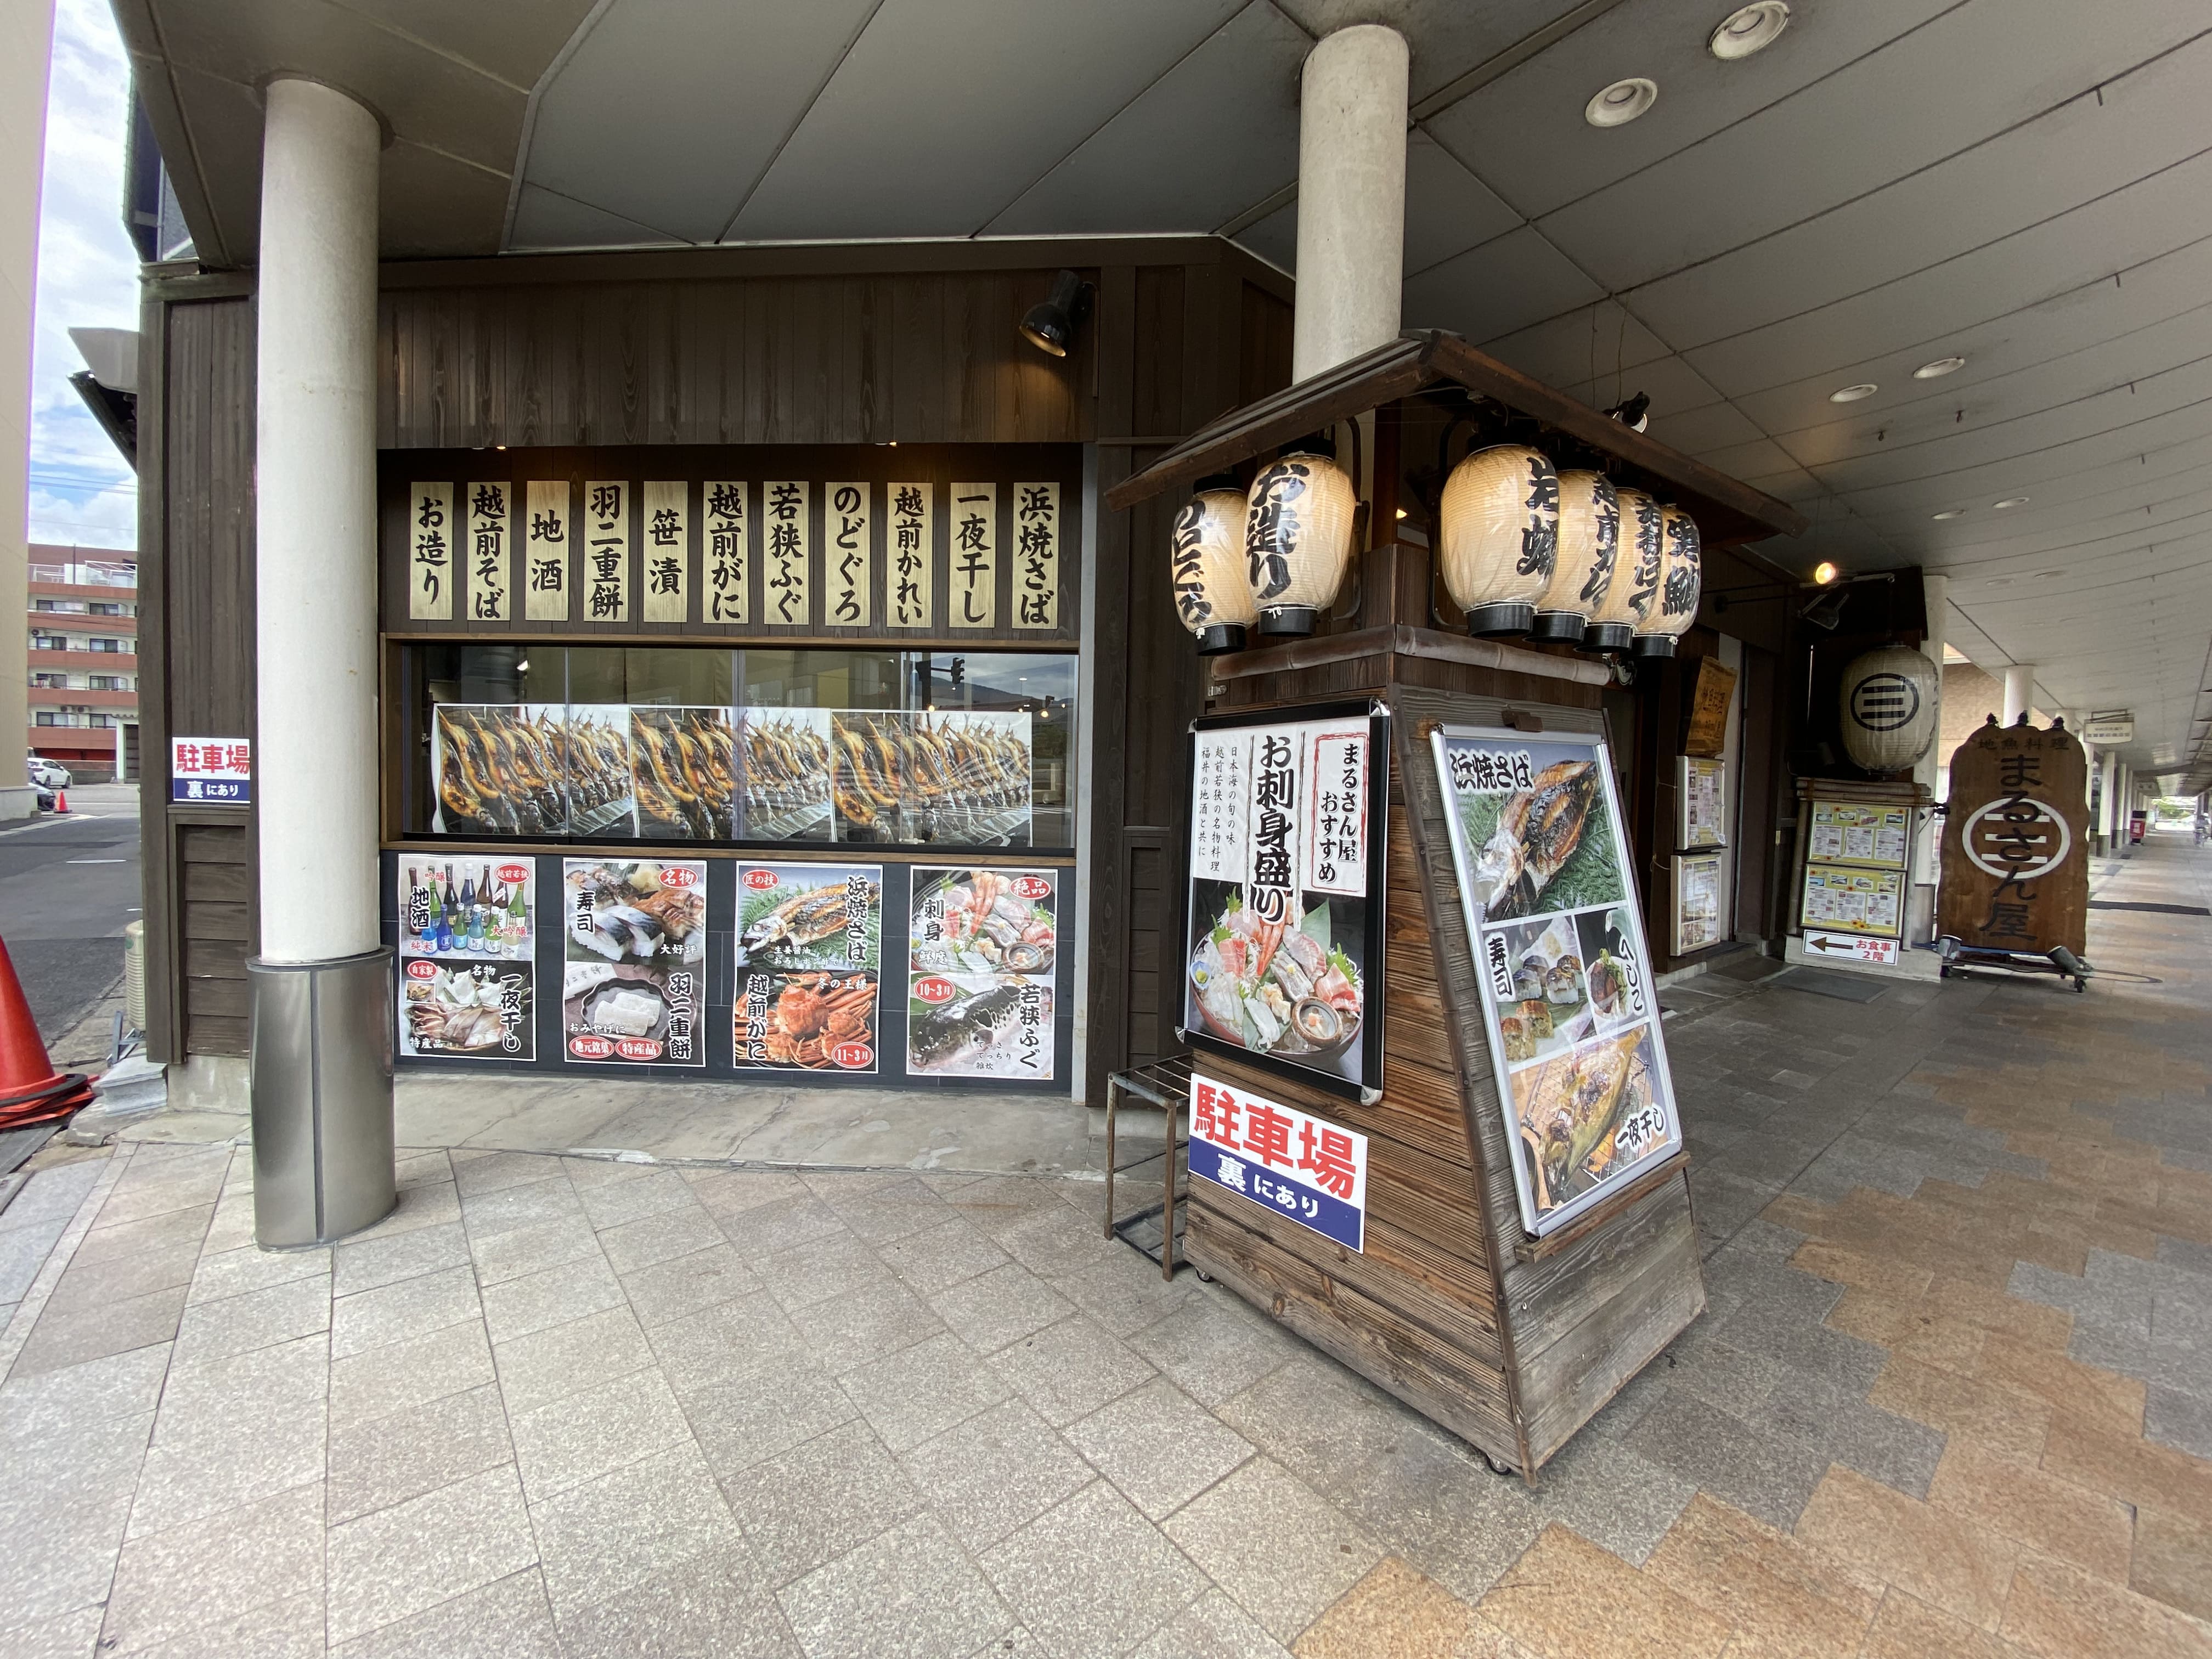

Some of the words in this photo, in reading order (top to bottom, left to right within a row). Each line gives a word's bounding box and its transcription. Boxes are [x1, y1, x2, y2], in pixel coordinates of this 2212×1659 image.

[415, 496, 448, 605] お造り
[472, 484, 506, 619] 越前そば
[531, 509, 564, 591] 地酒
[589, 485, 623, 619] 羽二重餅
[650, 509, 682, 595] 笹漬
[708, 484, 743, 620] 越前がに
[769, 483, 804, 623] 若狭ふぐ
[834, 487, 865, 622] のどぐろ
[894, 487, 924, 624] 越前かれい
[956, 494, 991, 623] 一夜干し
[1019, 487, 1054, 624] 浜焼さば
[1246, 464, 1310, 599] お造り
[177, 744, 250, 774] 駐車場
[1450, 753, 1533, 790] 浜焼さば
[1978, 737, 2069, 750] 地魚料理
[187, 781, 239, 798] 裏にあり
[1198, 747, 1211, 856] 福井の地酒と共に
[1211, 746, 1224, 872] 越前若狭の名物料理
[1226, 747, 1238, 845] 日本海の旬の味
[1338, 743, 1359, 861] まるさん屋
[1254, 735, 1294, 922] お刺身盛り
[1319, 791, 1340, 883] おすすめ
[1979, 754, 2042, 940] まるさん屋
[424, 871, 446, 882] 吟醸
[664, 871, 695, 884] 名物
[745, 874, 777, 885] 匠の技
[1013, 882, 1047, 896] 絶品
[412, 887, 429, 927] 地酒
[491, 926, 527, 937] 大吟醸
[577, 891, 595, 933] 寿司
[848, 877, 868, 961] 浜焼さば
[924, 900, 944, 941] 刺身
[411, 941, 432, 951] 純米
[412, 965, 434, 975] 自家製
[471, 964, 496, 977] 名物
[659, 944, 697, 955] 大好評
[774, 946, 810, 955] 生姜醤油
[774, 958, 839, 966] おろしポン酢で
[918, 950, 947, 965] 鮮度
[1488, 938, 1512, 995] 寿司
[1856, 940, 1892, 951] お食事
[818, 978, 867, 990] 冬の王様
[1622, 939, 1642, 1011] へしこ
[500, 974, 521, 1052] 一夜干し
[569, 1023, 625, 1034] おみやげに
[669, 973, 692, 1059] 羽二重餅
[747, 975, 769, 1060] 越前がに
[1020, 984, 1041, 1069] 若狭ふぐ
[410, 1037, 444, 1049] 特産品
[575, 1041, 610, 1053] 地元銘菓
[622, 1042, 657, 1056] 特産品
[976, 1062, 993, 1070] 雑炊
[1194, 1082, 1356, 1199] 駐車場
[1618, 1109, 1664, 1148] 一夜干し
[1217, 1153, 1318, 1217] 裏にあり
